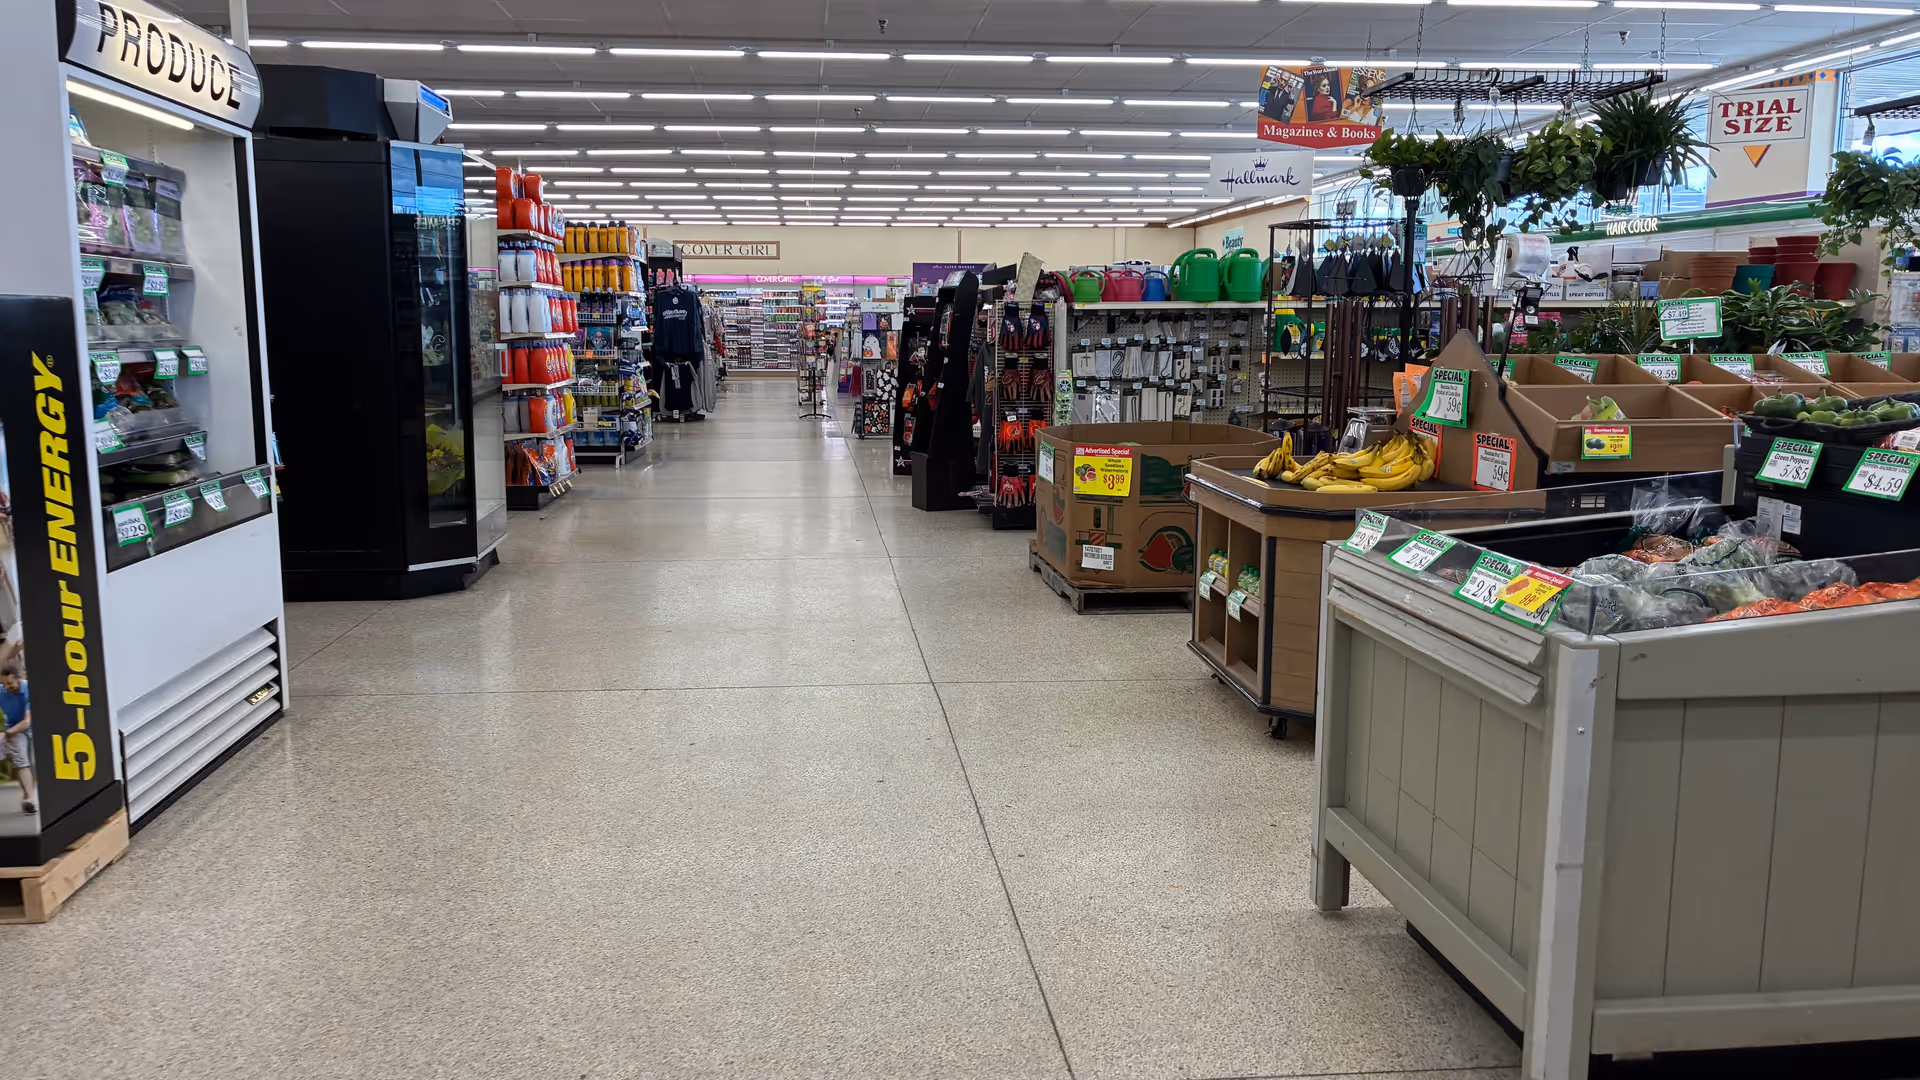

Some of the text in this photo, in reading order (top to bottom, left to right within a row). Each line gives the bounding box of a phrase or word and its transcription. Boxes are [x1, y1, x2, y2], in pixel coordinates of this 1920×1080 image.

[97, 2, 241, 110] PRODUCE
[1717, 97, 1802, 118] TRIAL
[1263, 124, 1376, 139] Magazines & Books
[1723, 115, 1792, 136] SIZE
[1220, 167, 1301, 193] Hallmark
[1606, 217, 1658, 236] HAIR COLOR
[681, 244, 773, 256] COVER GIRL
[1225, 236, 1244, 250] Beauty
[1667, 310, 1687, 319] $7.49
[1434, 370, 1467, 383] SPECIAL!
[1650, 369, 1677, 379] $2.59
[1476, 434, 1514, 451] SPECIAL!
[1111, 448, 1130, 456] Special
[1774, 453, 1810, 465] Green Peppers
[1780, 465, 1809, 482] 5/$5
[1864, 472, 1903, 493] $4.59
[51, 580, 97, 781] 5-hour
